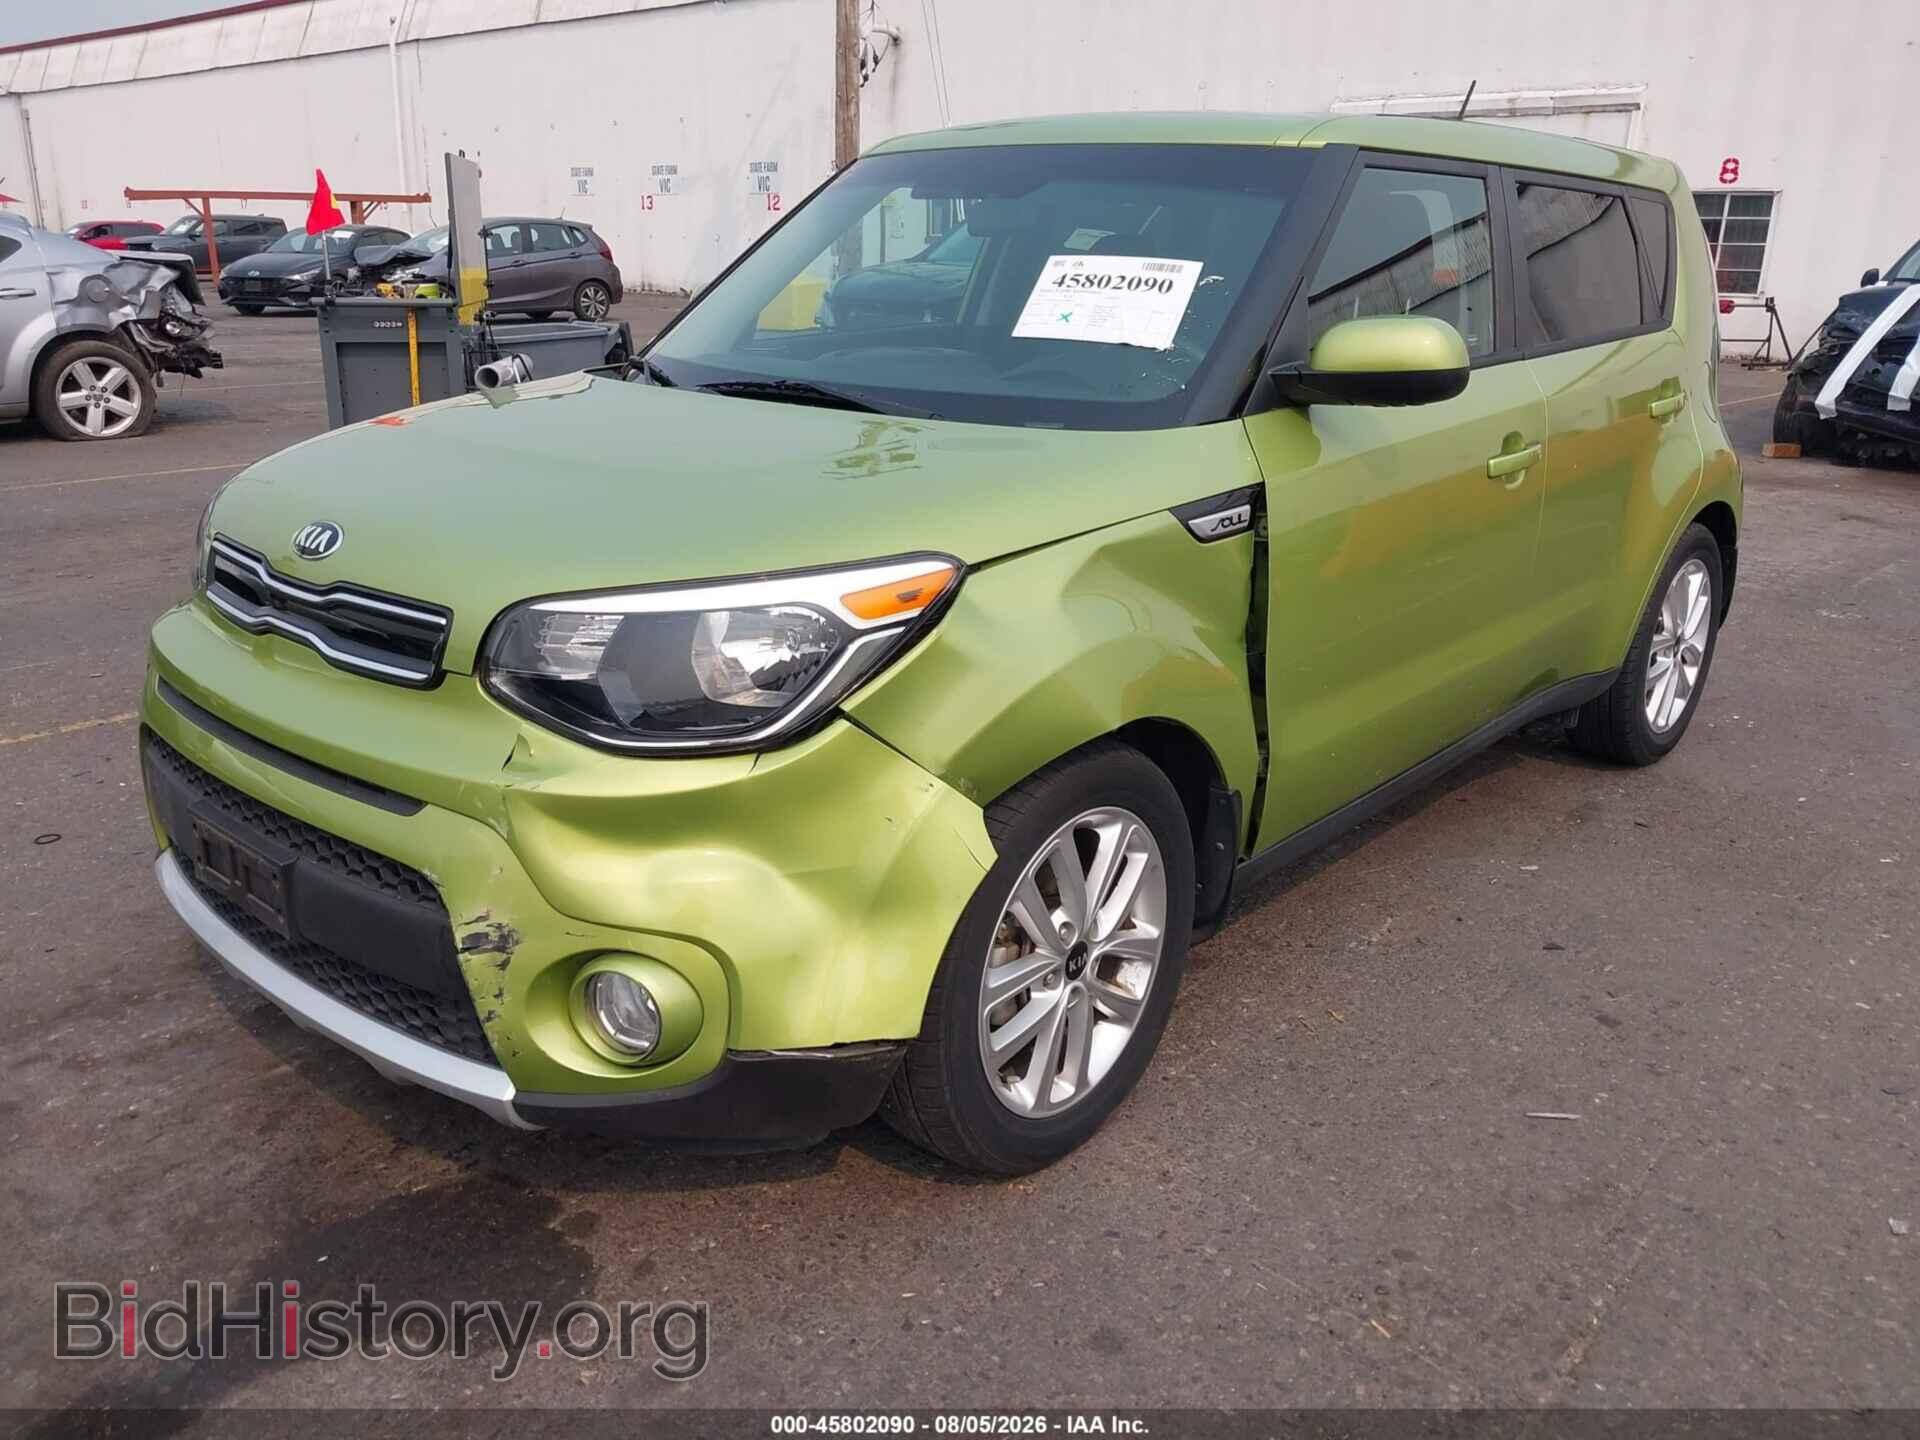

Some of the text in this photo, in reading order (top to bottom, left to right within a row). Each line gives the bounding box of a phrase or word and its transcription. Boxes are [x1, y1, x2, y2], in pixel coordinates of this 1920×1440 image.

[1719, 157, 1740, 184] 8
[659, 177, 671, 193] VIC
[757, 175, 770, 192] VIC
[641, 195, 654, 210] 13
[767, 193, 781, 211] 12
[1052, 272, 1174, 295] 45802090
[295, 526, 333, 553] KIA
